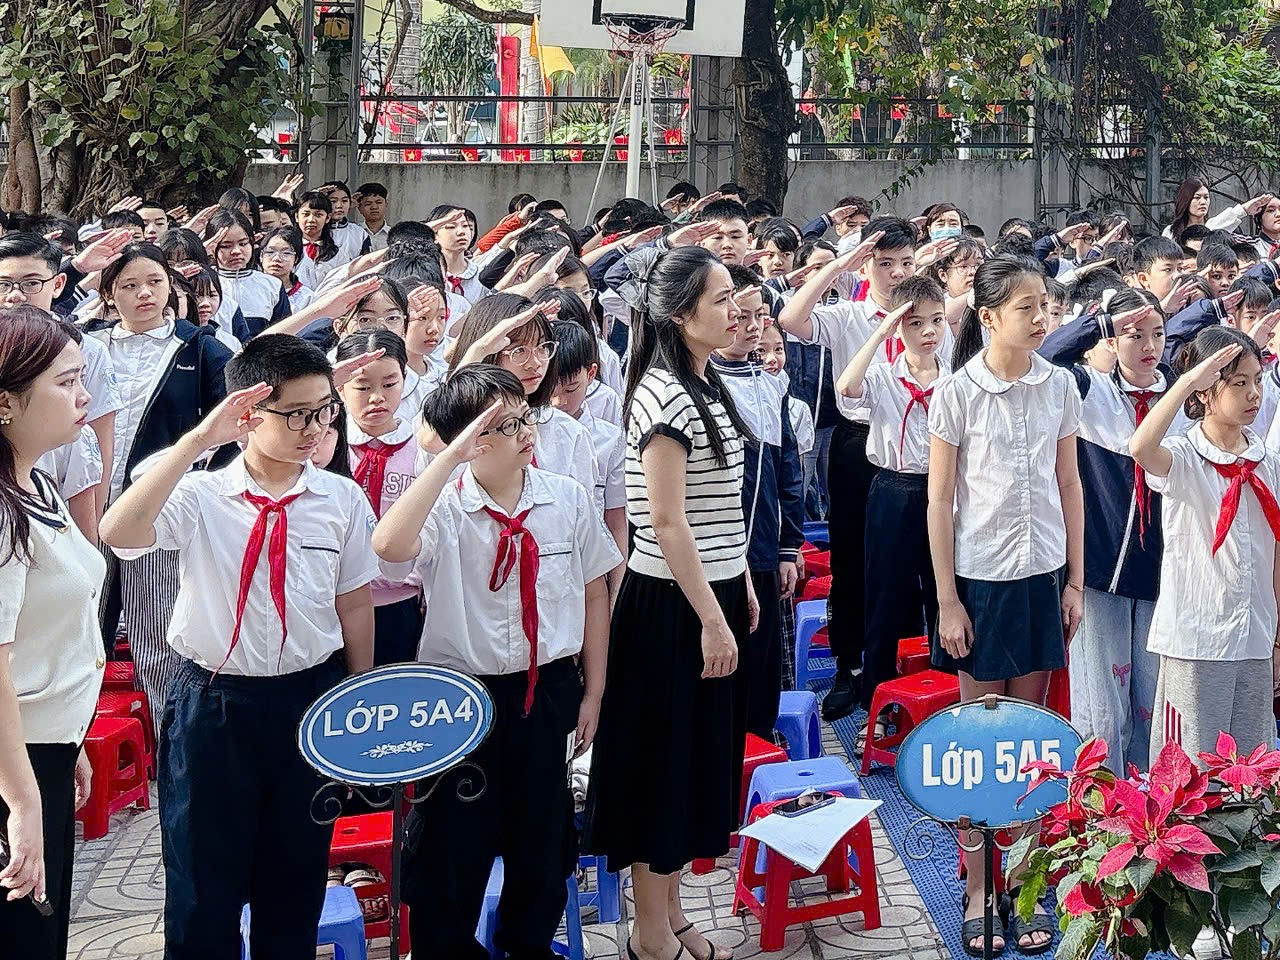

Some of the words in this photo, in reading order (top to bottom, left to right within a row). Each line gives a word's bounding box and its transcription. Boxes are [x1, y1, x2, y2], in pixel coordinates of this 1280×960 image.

[323, 699, 399, 737] LỚP
[409, 696, 474, 728] 5A4
[922, 741, 984, 790] Lớp
